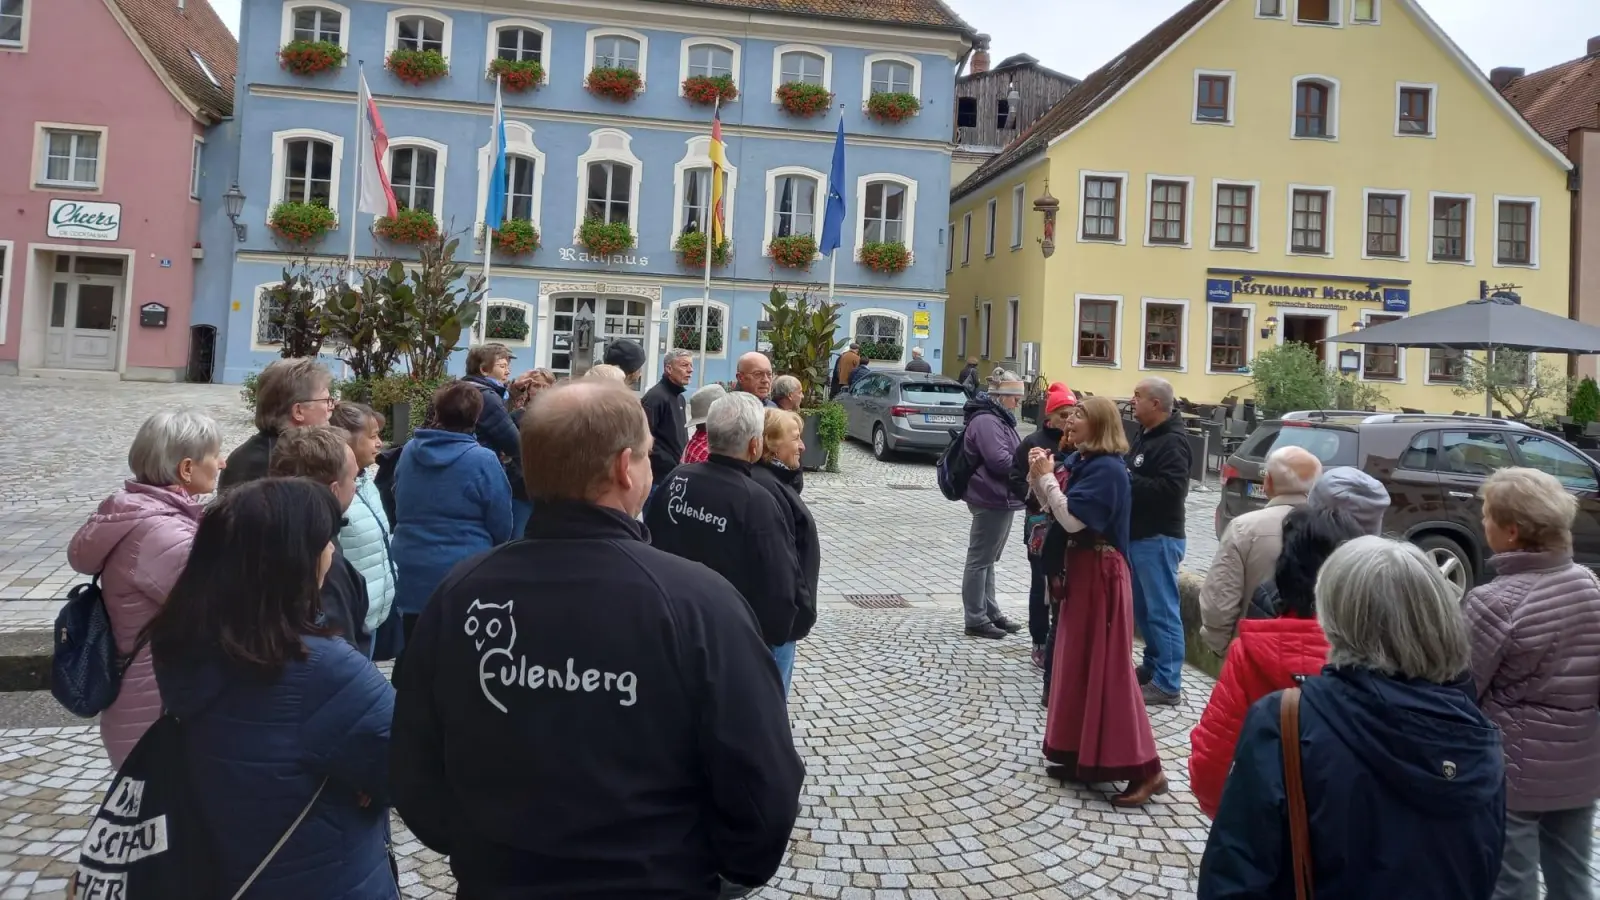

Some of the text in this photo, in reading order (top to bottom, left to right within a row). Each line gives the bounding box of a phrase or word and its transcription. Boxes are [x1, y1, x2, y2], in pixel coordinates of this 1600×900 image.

[53, 203, 118, 230] Cheers
[558, 247, 650, 266] Rathaus
[668, 495, 727, 532] Eulenberg
[479, 647, 638, 714] Eulenberg
